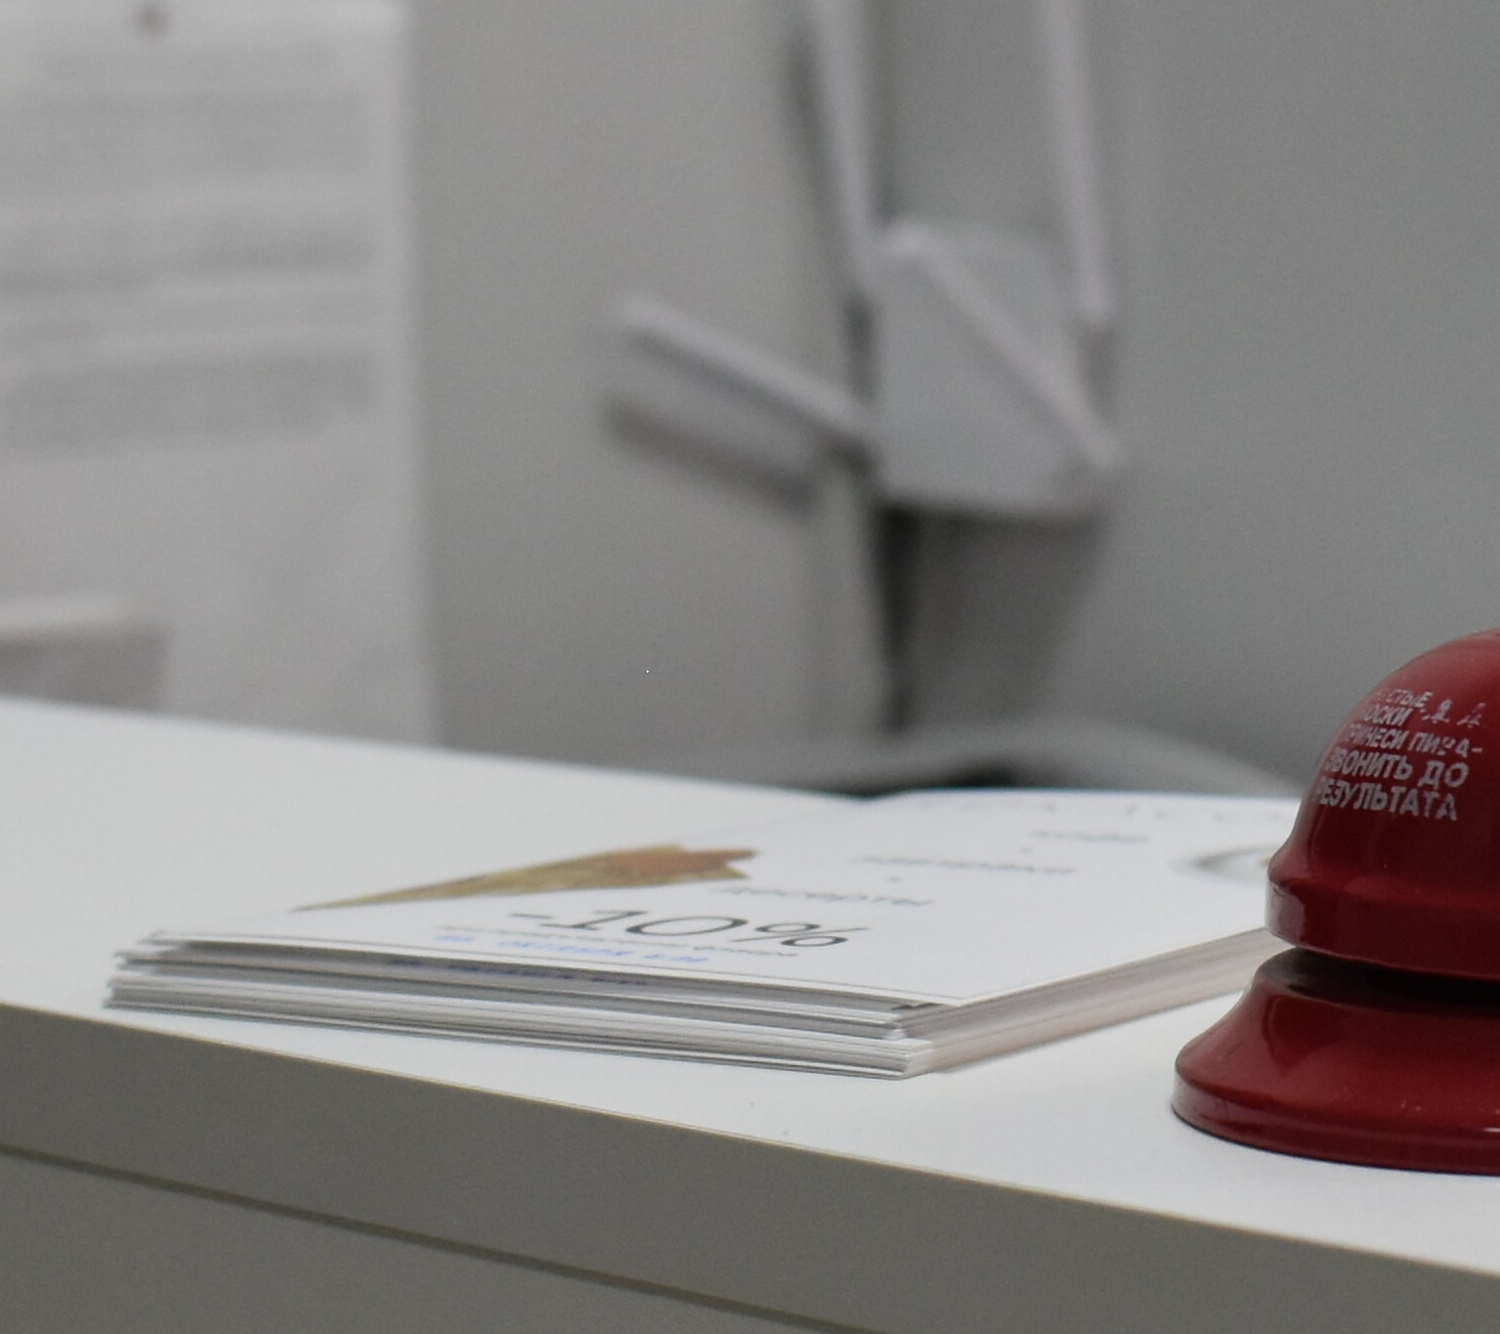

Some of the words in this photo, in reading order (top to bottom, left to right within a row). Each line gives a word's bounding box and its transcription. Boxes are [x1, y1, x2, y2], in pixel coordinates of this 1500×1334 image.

[1374, 688, 1433, 708] СТЫЕ
[1360, 704, 1413, 726] ОСКИ
[1346, 723, 1409, 750] РИНЕСИ
[1323, 747, 1413, 780] ЗВОНИТЬ
[1417, 760, 1469, 790] ДО
[1315, 775, 1458, 821] РЕЗУЛЬТАТА
[510, 909, 871, 948] -10%
